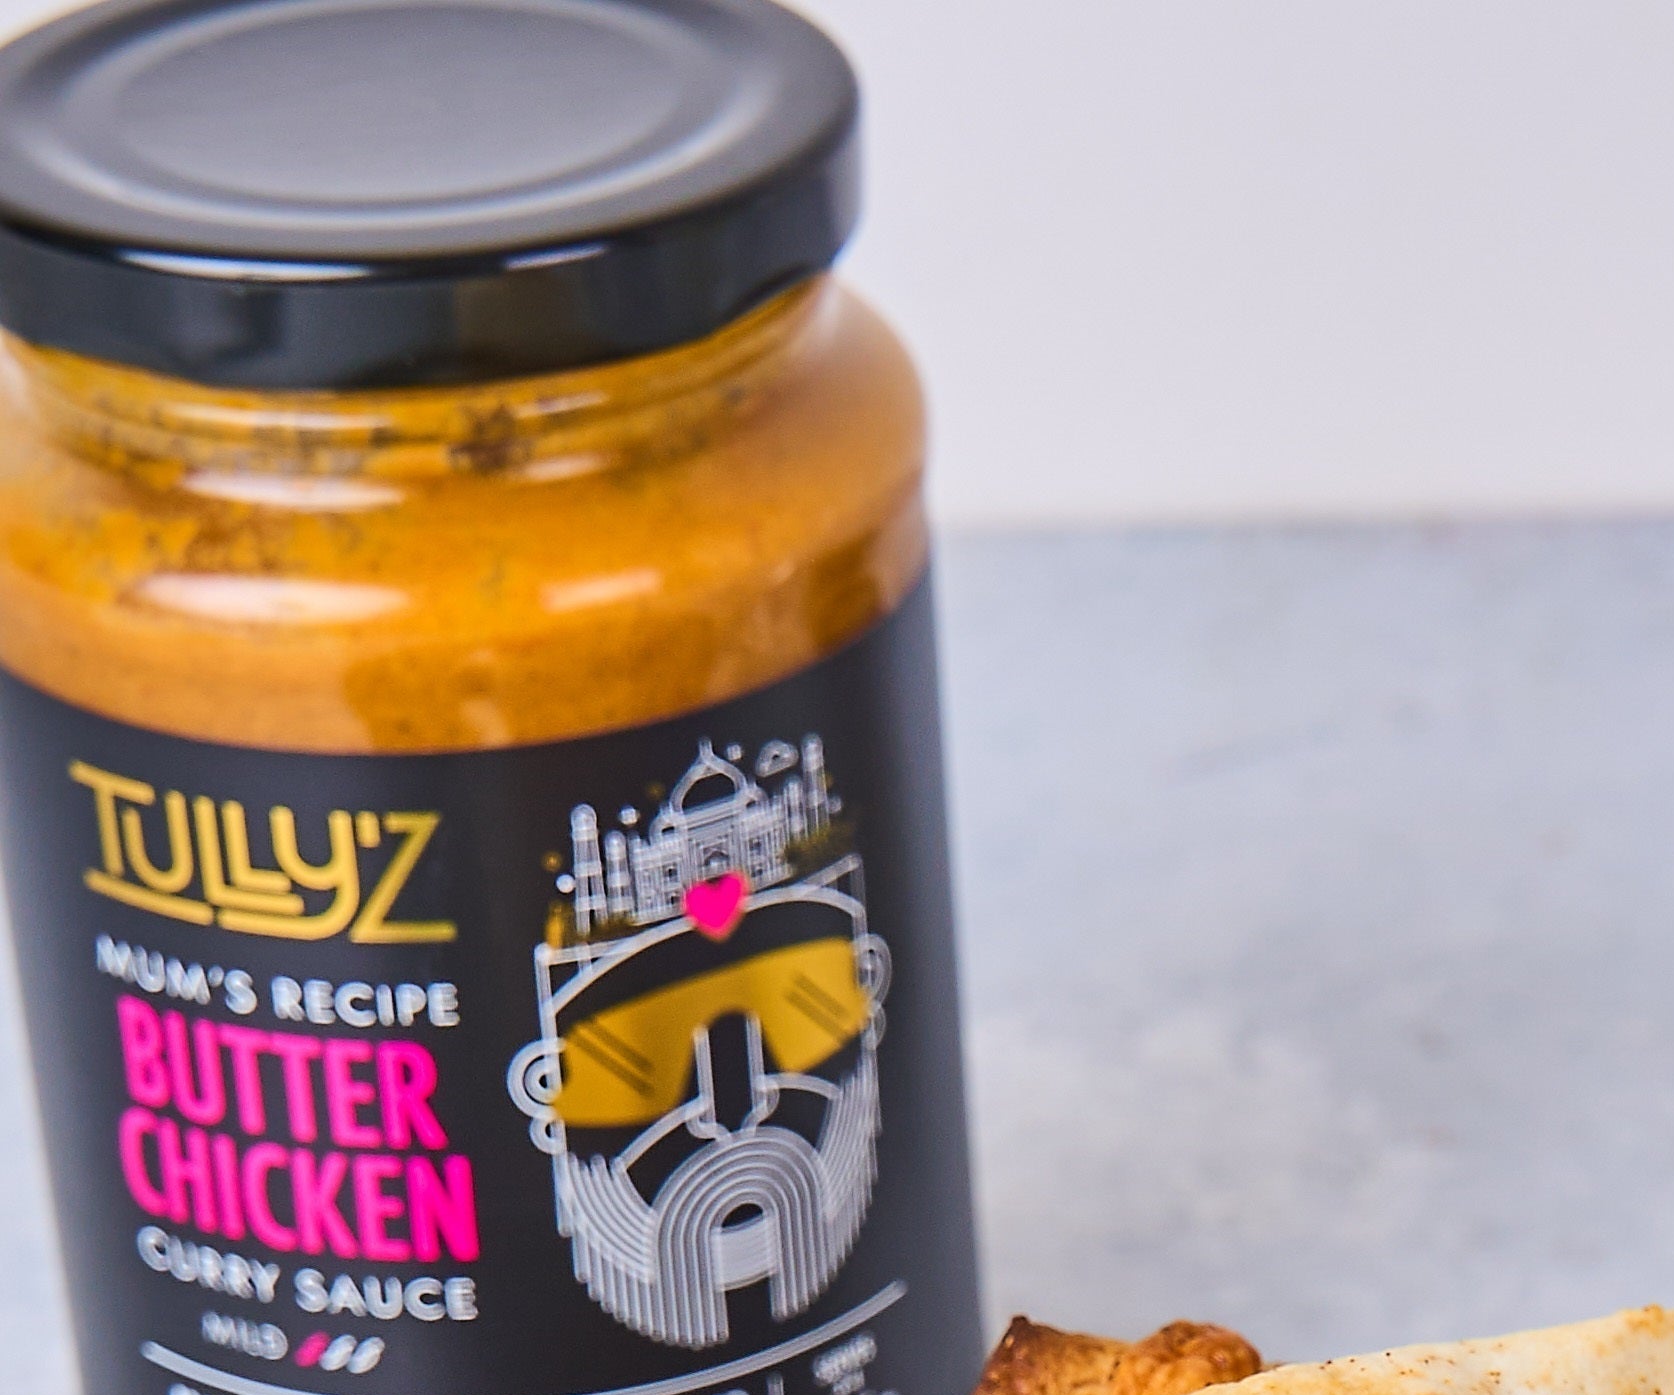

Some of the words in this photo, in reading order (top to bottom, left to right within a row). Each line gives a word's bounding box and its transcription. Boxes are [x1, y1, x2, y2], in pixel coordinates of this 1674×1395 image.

[95, 933, 257, 1016] MUM'S
[271, 974, 461, 1027] RECIPE
[116, 994, 450, 1151] BUTTER
[119, 1106, 480, 1262] CHICKEN
[136, 1225, 281, 1303] CURRY
[294, 1267, 480, 1321] SAUCE
